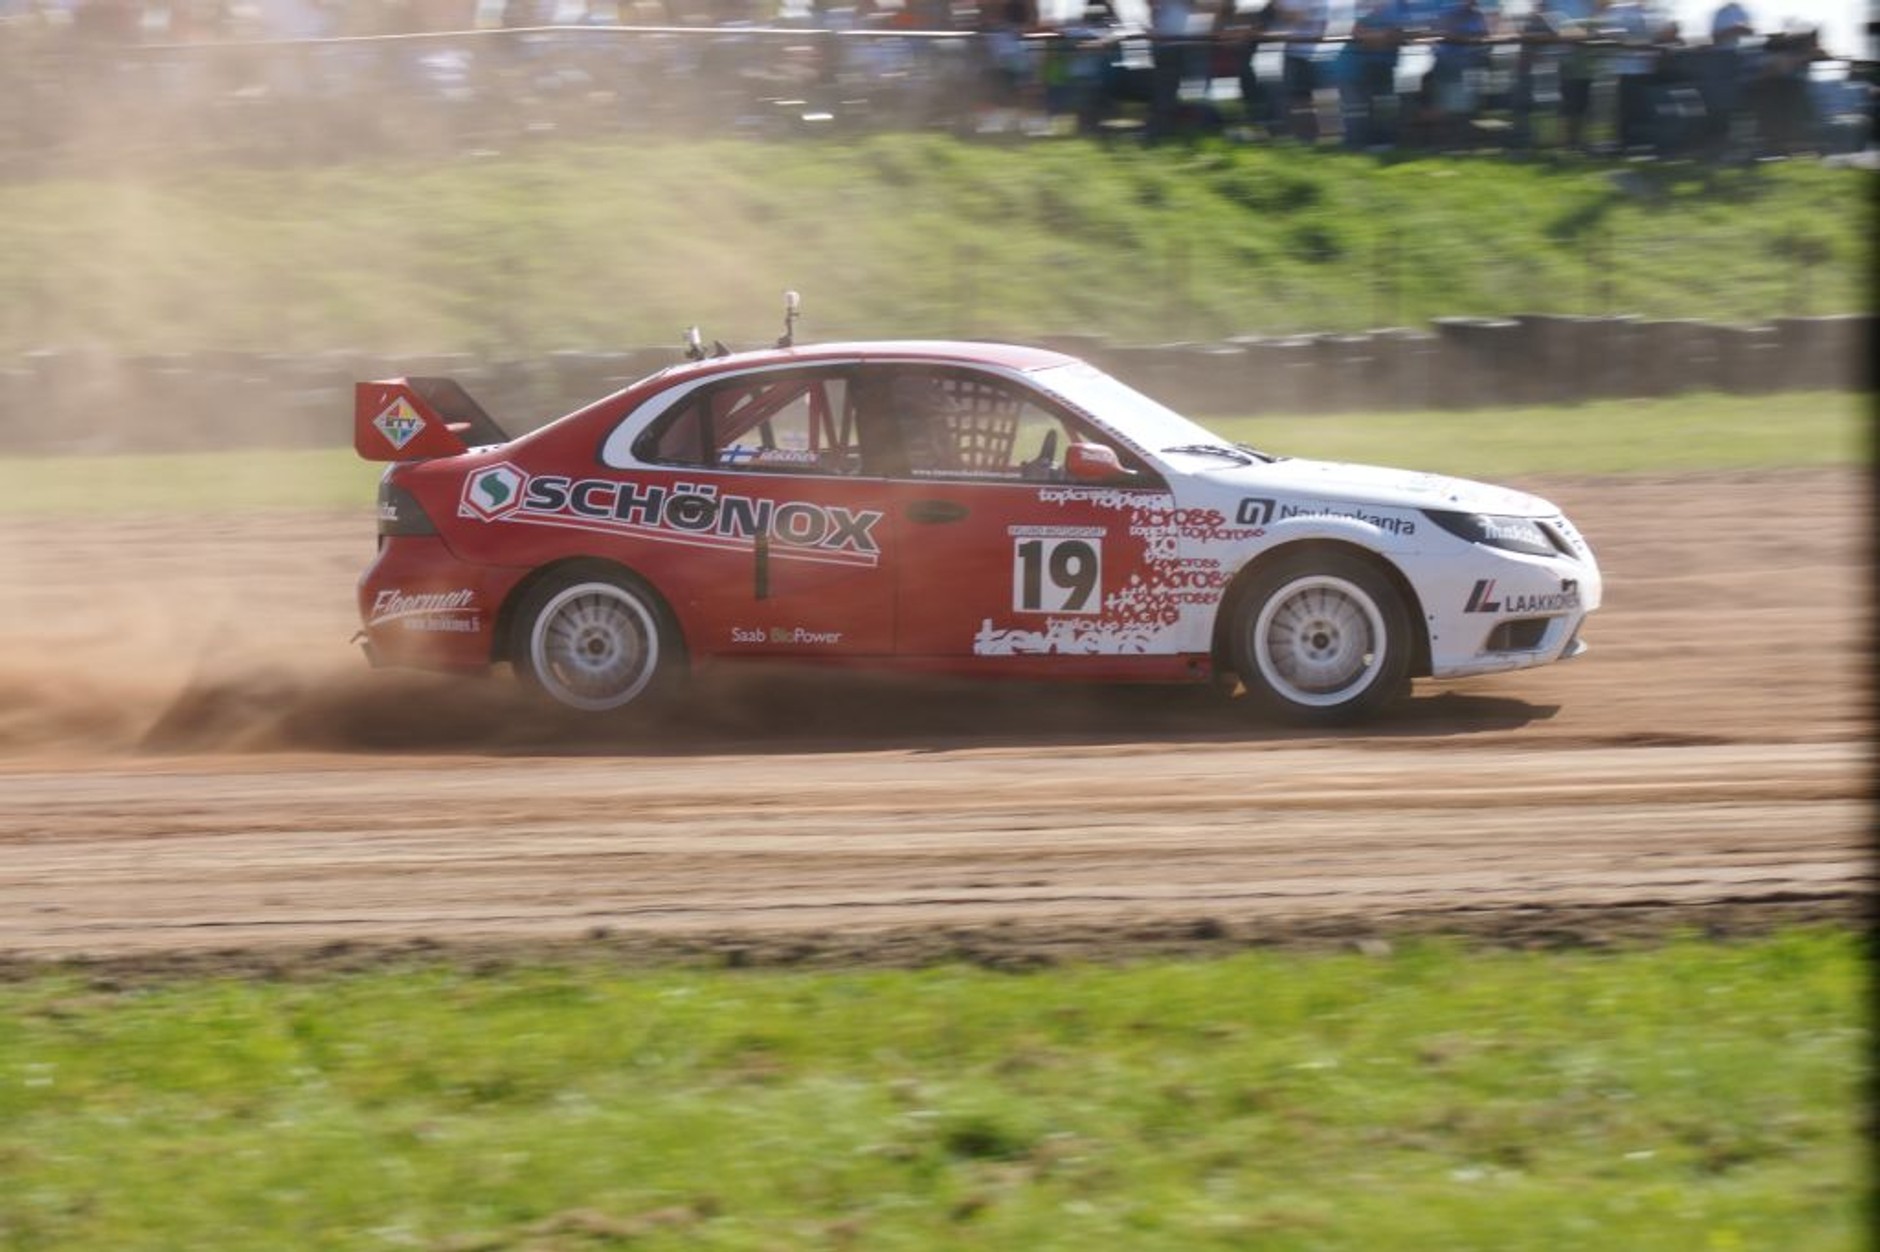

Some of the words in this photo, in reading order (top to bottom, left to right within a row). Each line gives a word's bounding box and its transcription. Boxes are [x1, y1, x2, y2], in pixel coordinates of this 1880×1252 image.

[525, 475, 885, 554] SCHÖNOX
[1017, 538, 1099, 612] 19
[731, 627, 766, 643] Saab
